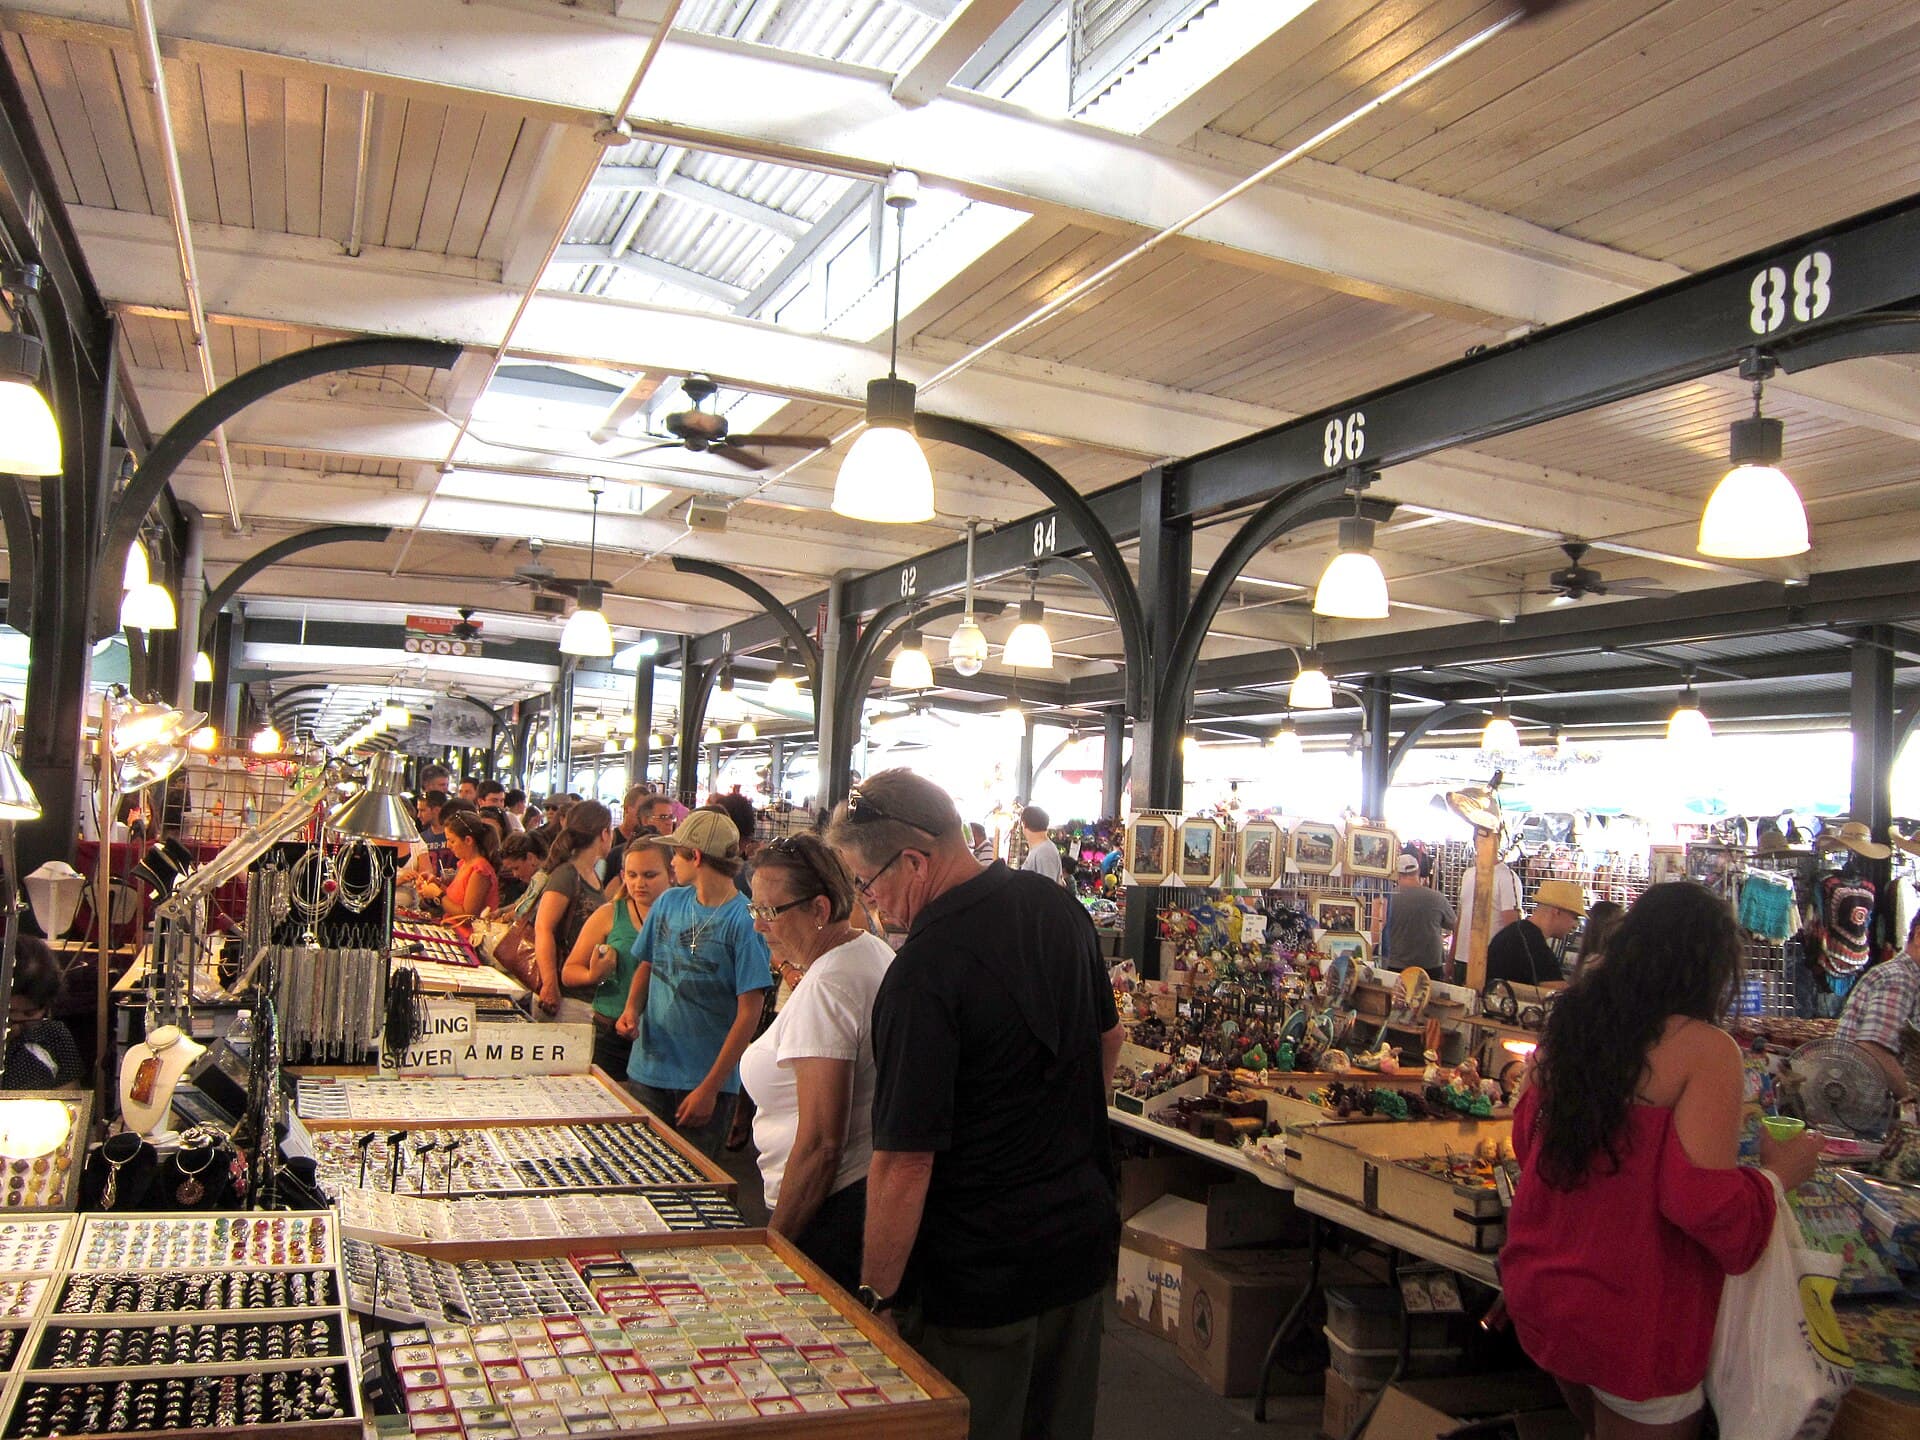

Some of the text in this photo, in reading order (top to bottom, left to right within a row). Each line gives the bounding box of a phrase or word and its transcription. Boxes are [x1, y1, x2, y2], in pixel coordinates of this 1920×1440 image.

[1749, 251, 1832, 335] 88
[1323, 411, 1366, 468] 86
[1033, 516, 1056, 557] 84
[900, 565, 917, 598] 82
[721, 631, 731, 653] 78
[381, 1049, 452, 1069] SILVER
[464, 1045, 565, 1061] AMBER
